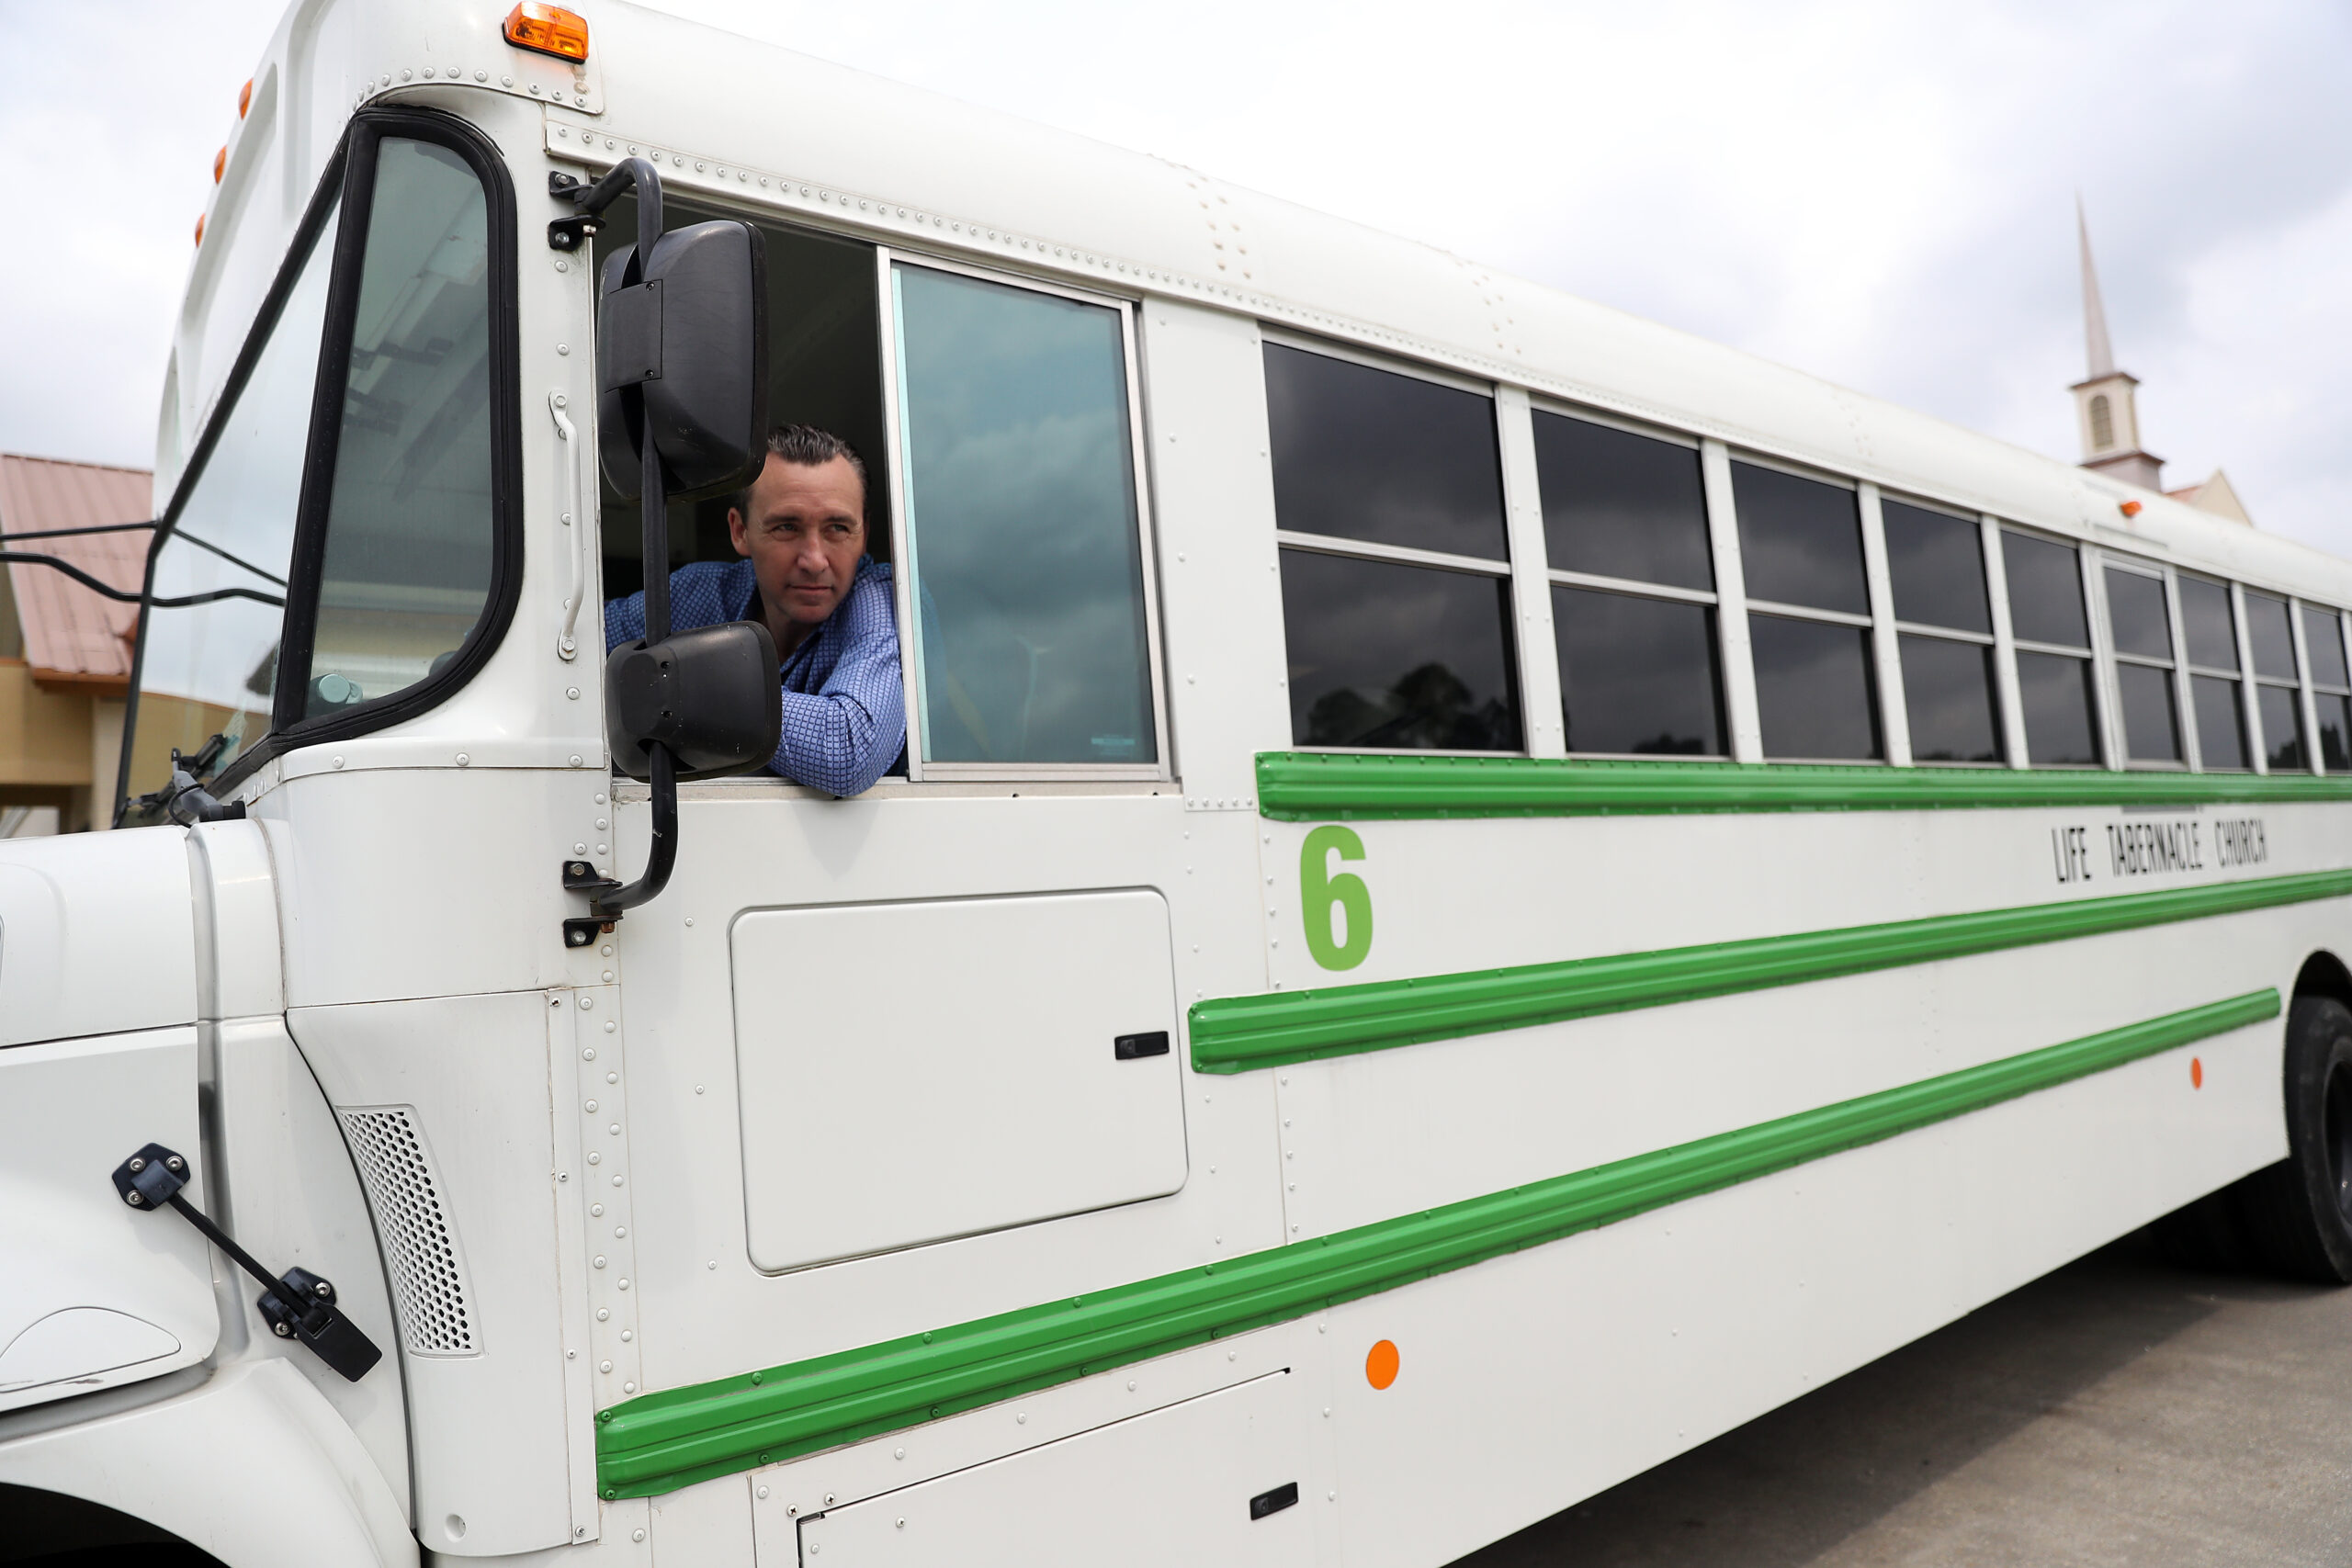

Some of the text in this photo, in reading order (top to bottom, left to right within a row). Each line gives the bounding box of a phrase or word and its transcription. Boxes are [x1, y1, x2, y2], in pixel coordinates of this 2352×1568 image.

[1300, 825, 1374, 972] 6
[2052, 818, 2267, 884] LIFE TABERNACLE CHURCH
